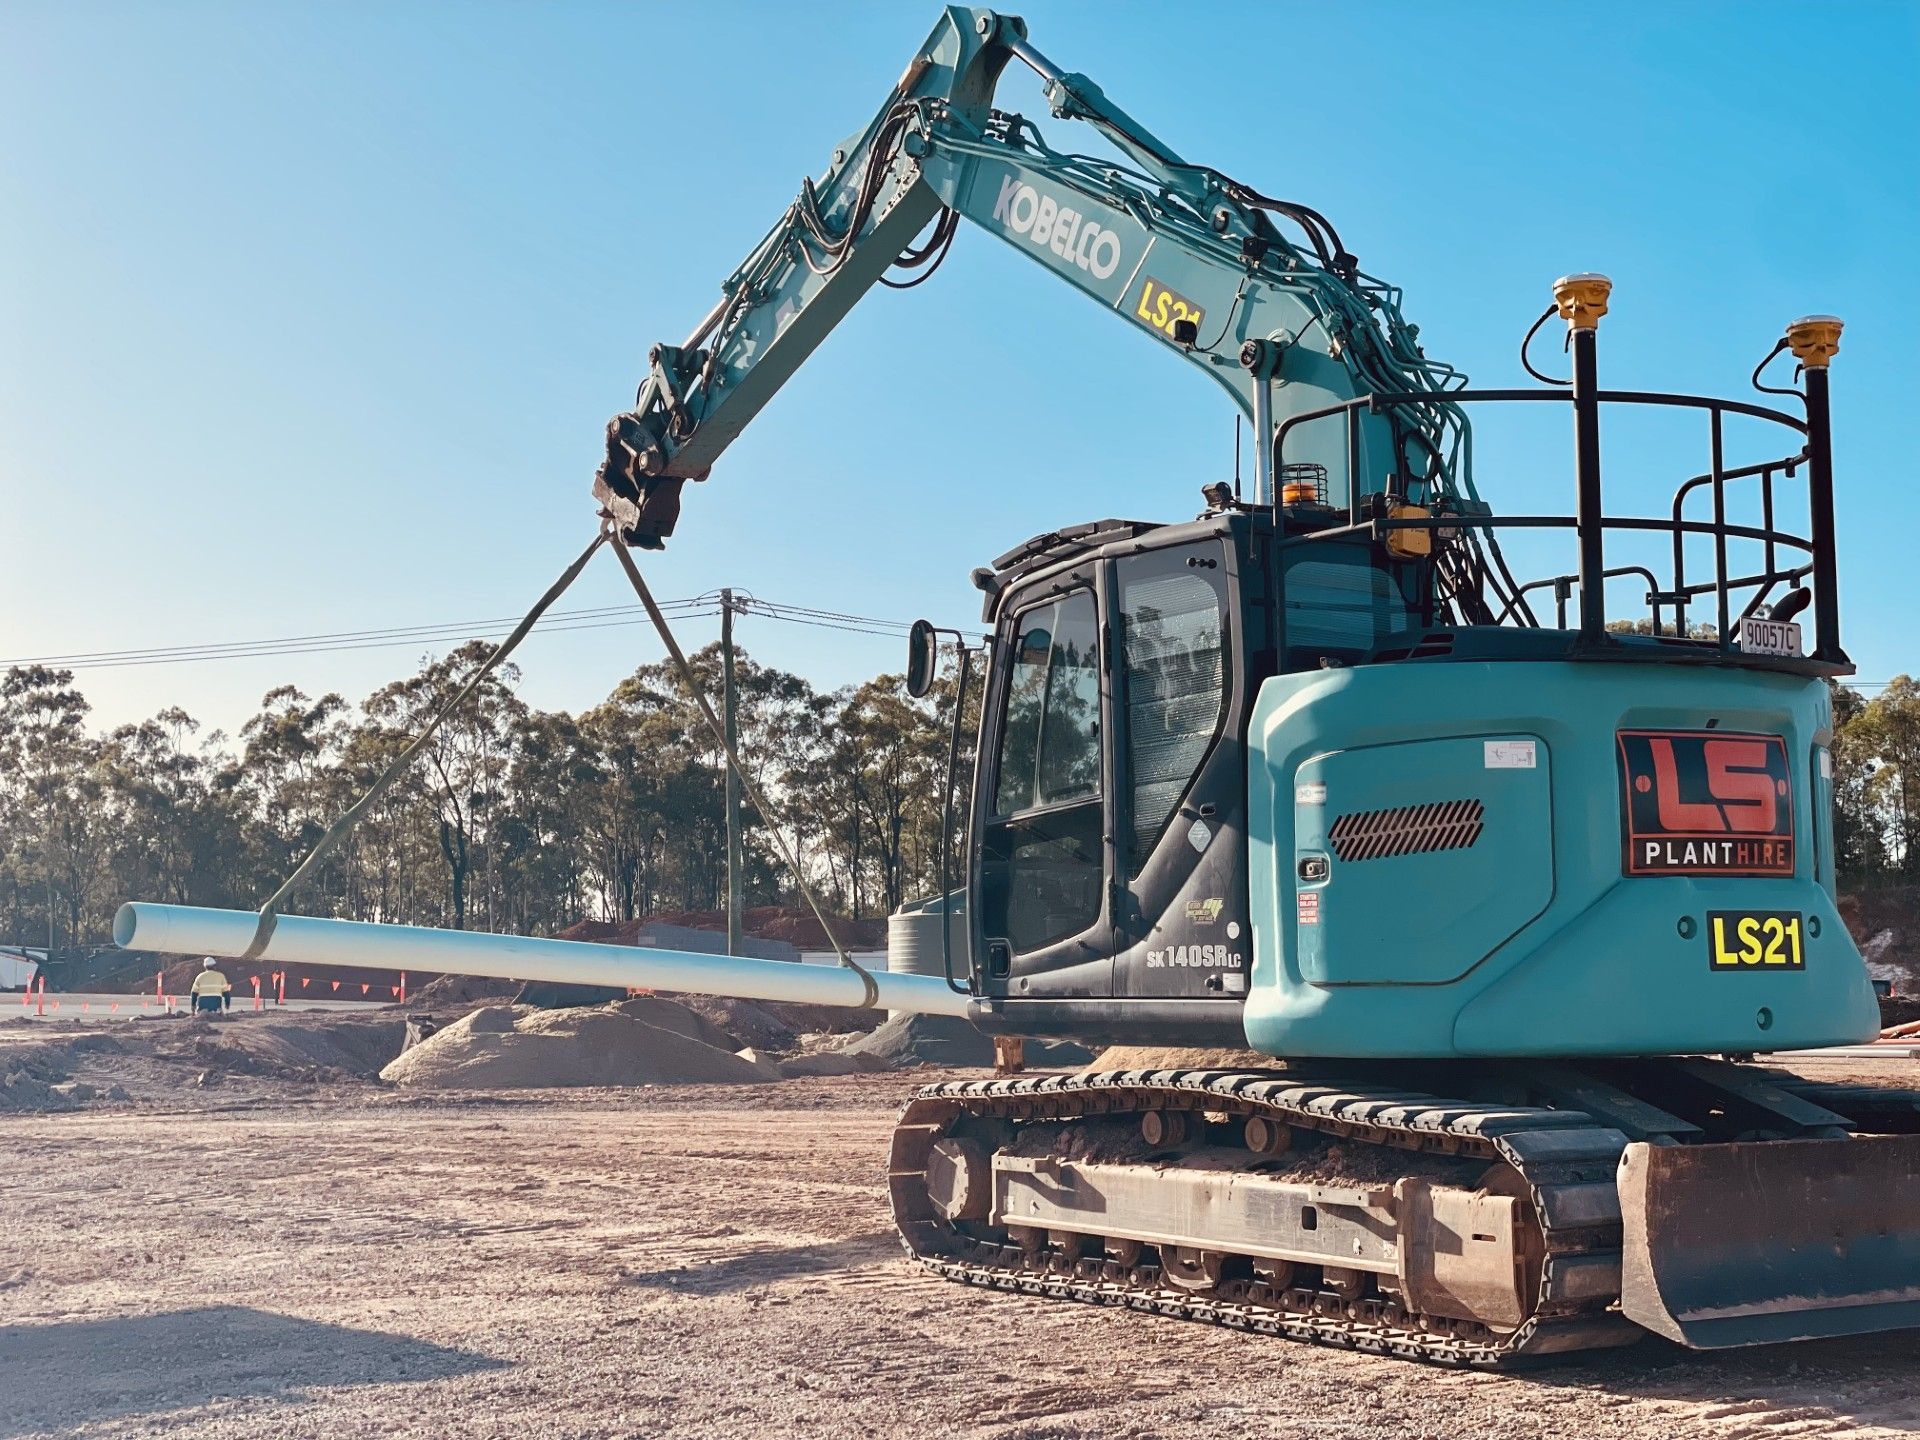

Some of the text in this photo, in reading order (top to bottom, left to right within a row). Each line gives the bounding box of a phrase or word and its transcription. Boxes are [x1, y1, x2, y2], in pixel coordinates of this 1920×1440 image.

[992, 174, 1121, 280] KOBELCO
[1746, 622, 1795, 651] 90057C
[1648, 738, 1777, 833] LS
[1713, 916, 1801, 965] LS21
